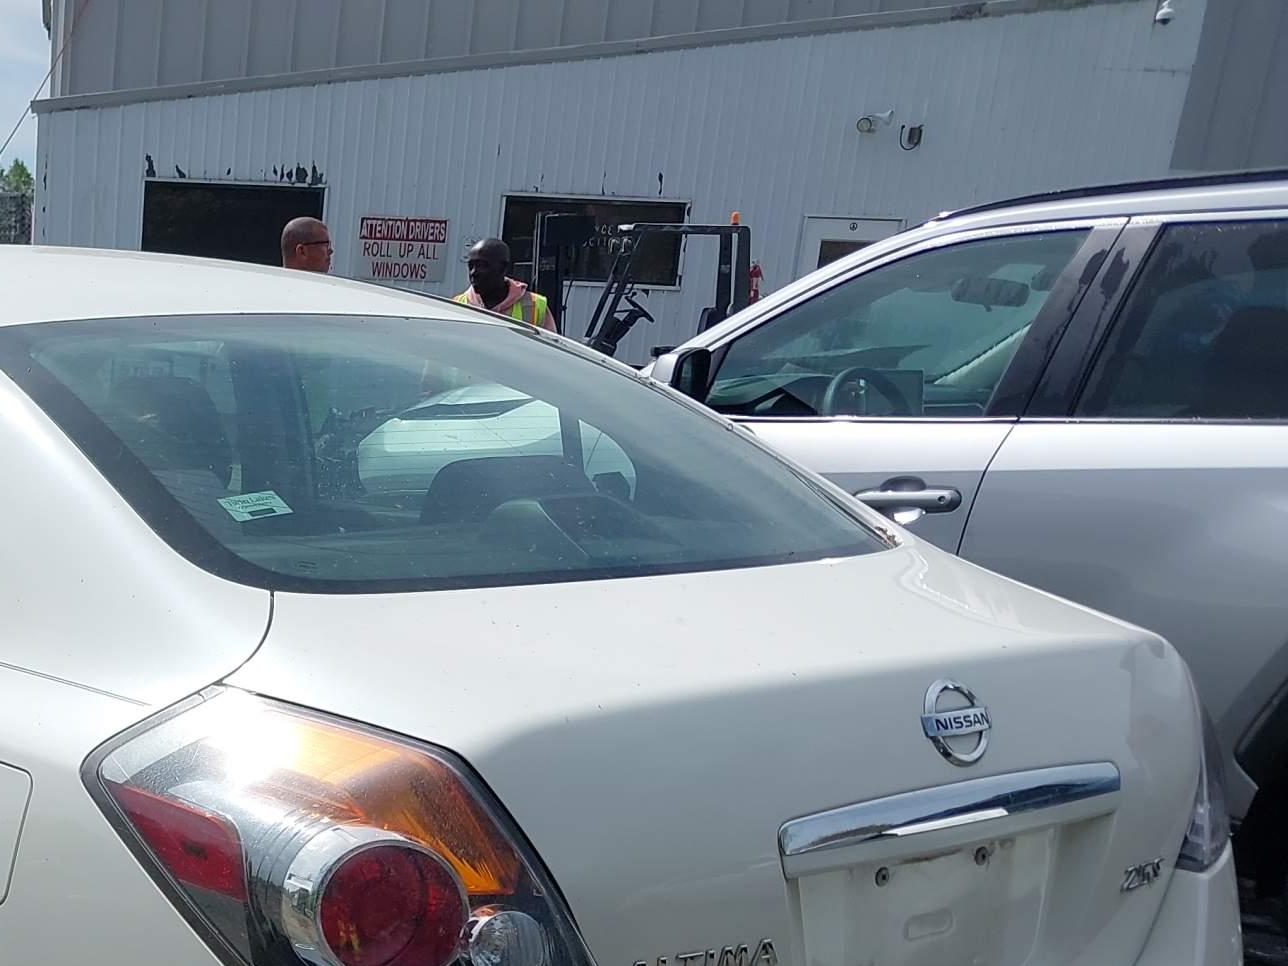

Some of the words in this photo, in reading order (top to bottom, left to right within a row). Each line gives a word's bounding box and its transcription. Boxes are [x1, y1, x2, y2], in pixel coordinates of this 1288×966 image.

[361, 219, 408, 239] ATTENTION
[408, 221, 446, 241] DRIVERS
[363, 242, 392, 258] ROLL
[398, 243, 414, 258] UP
[417, 243, 439, 260] ALL
[371, 261, 427, 279] WINDOWS
[934, 711, 990, 731] NISSAN
